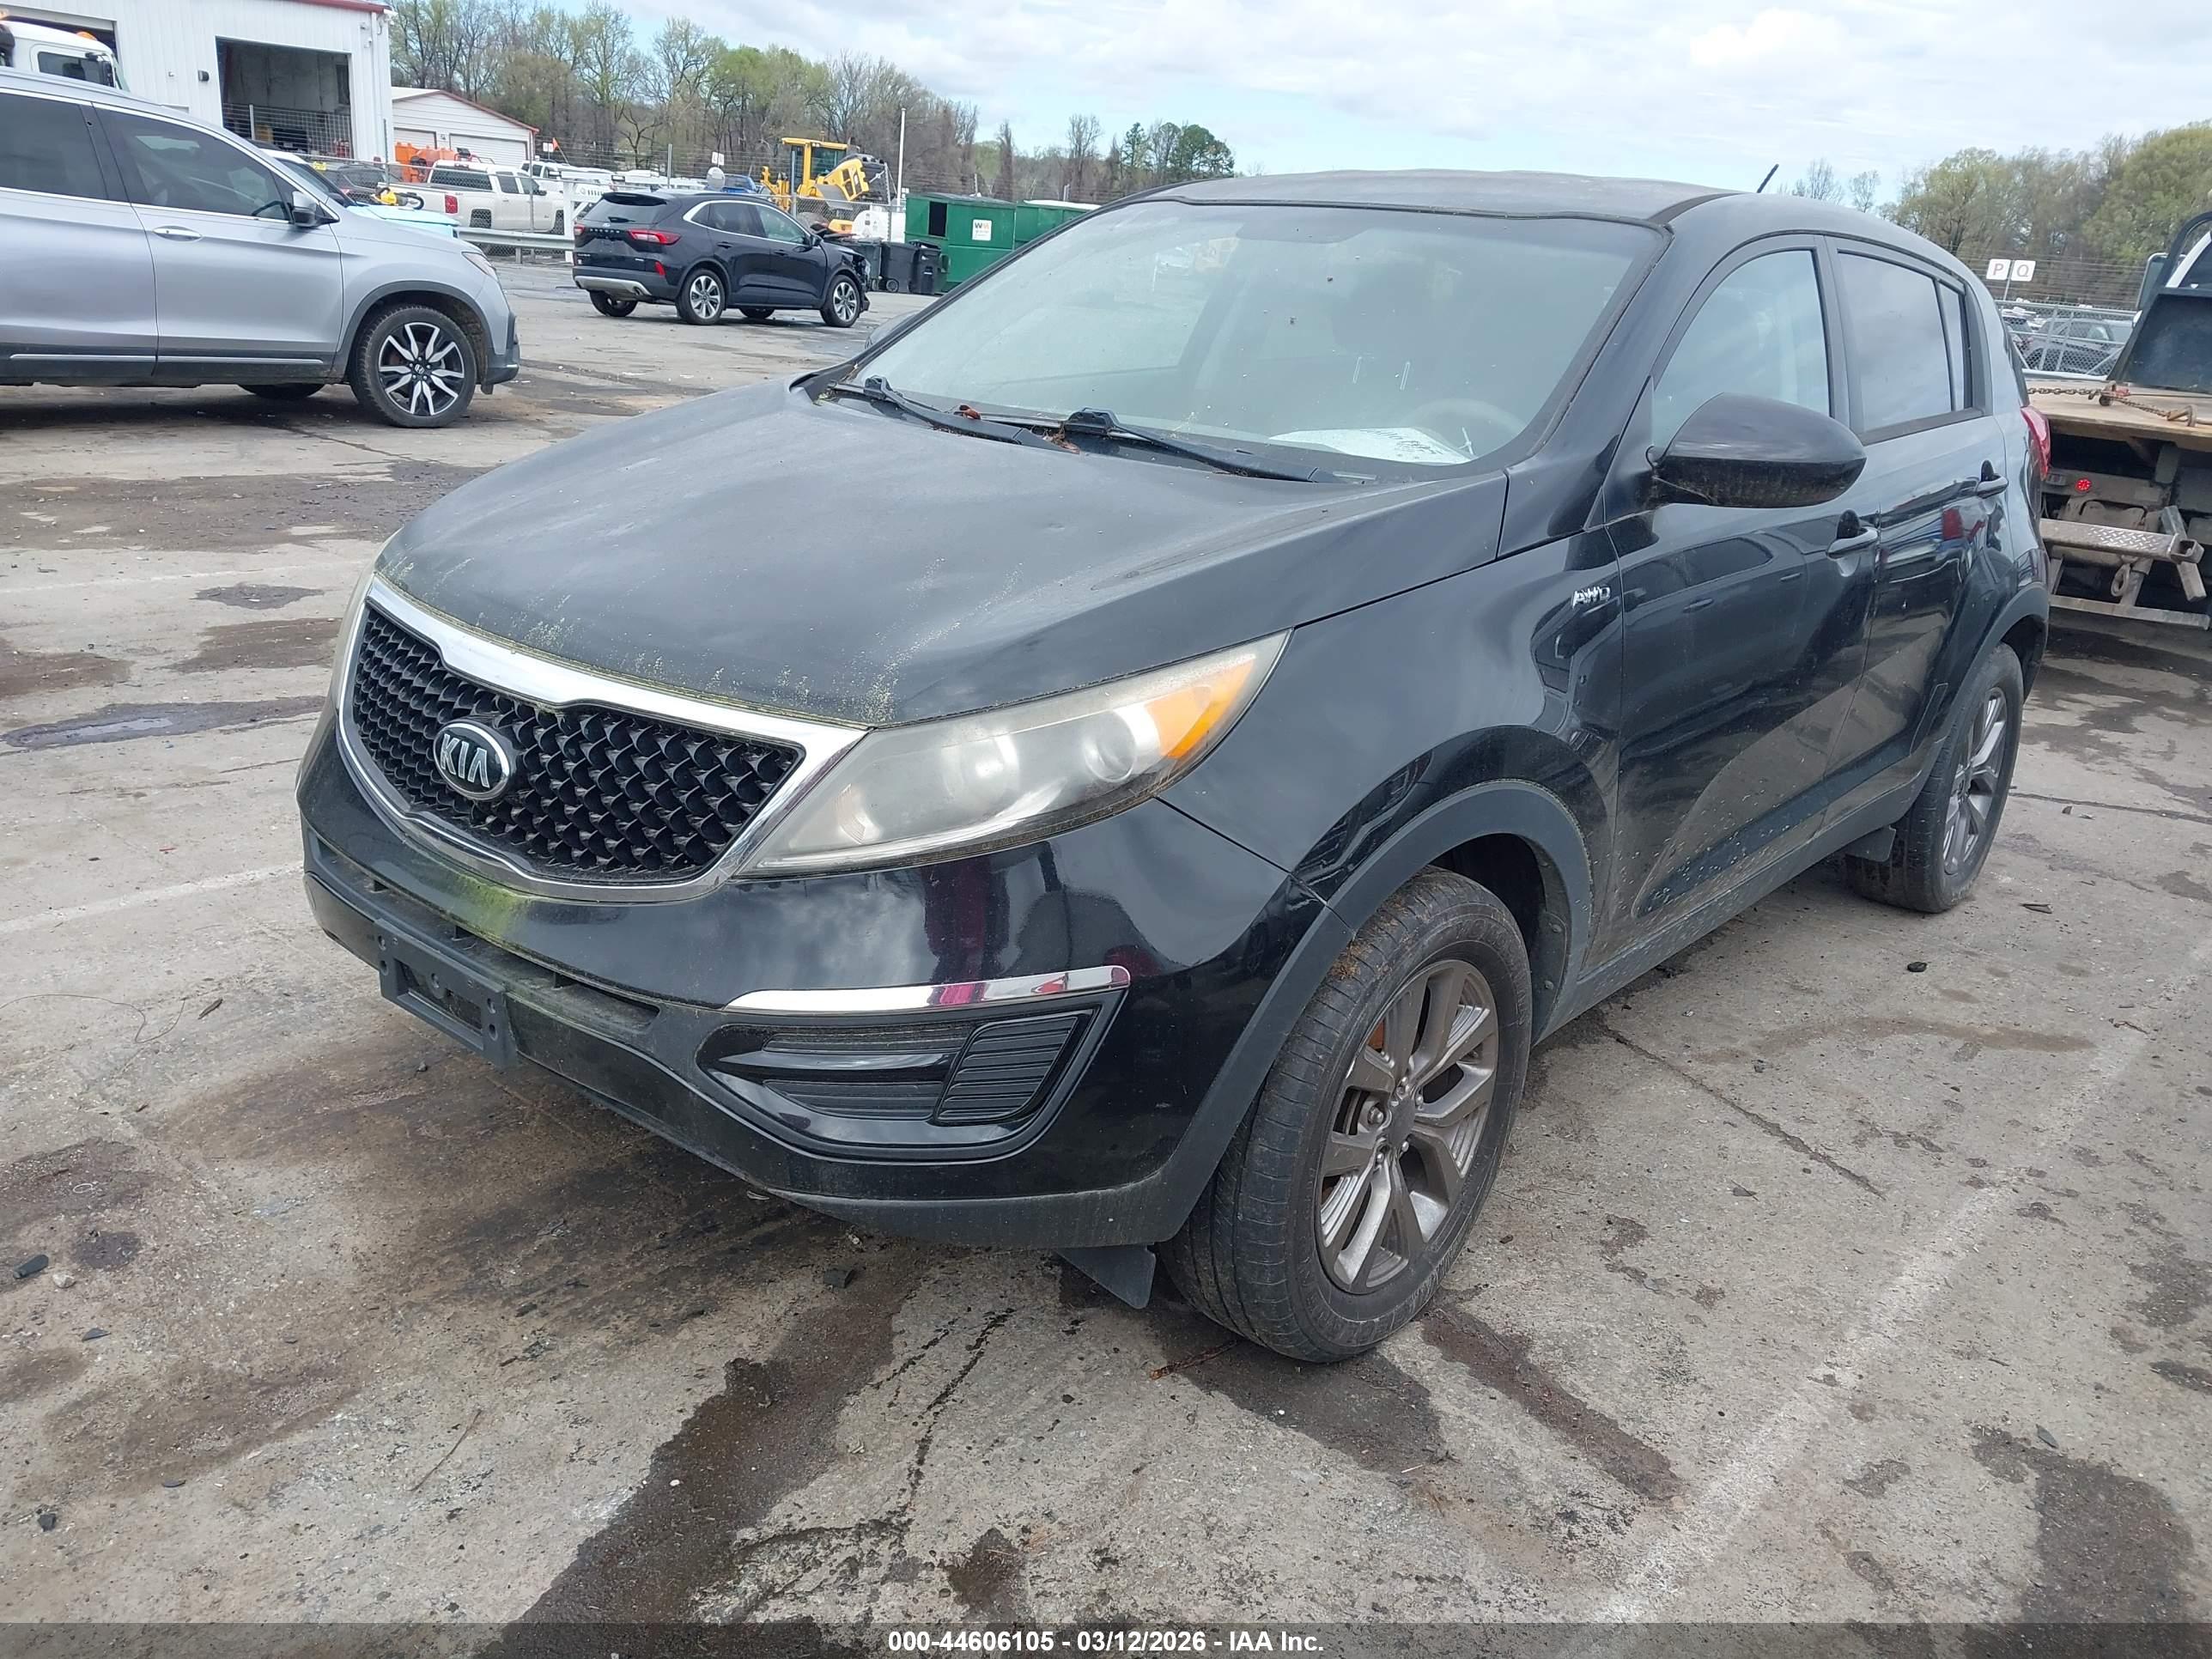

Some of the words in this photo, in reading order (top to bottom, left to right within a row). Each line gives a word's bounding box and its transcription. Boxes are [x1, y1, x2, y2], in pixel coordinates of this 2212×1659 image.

[1992, 263, 2004, 276] P
[2016, 264, 2030, 277] Q
[1571, 586, 1611, 609] AWD
[440, 733, 490, 788] KIA
